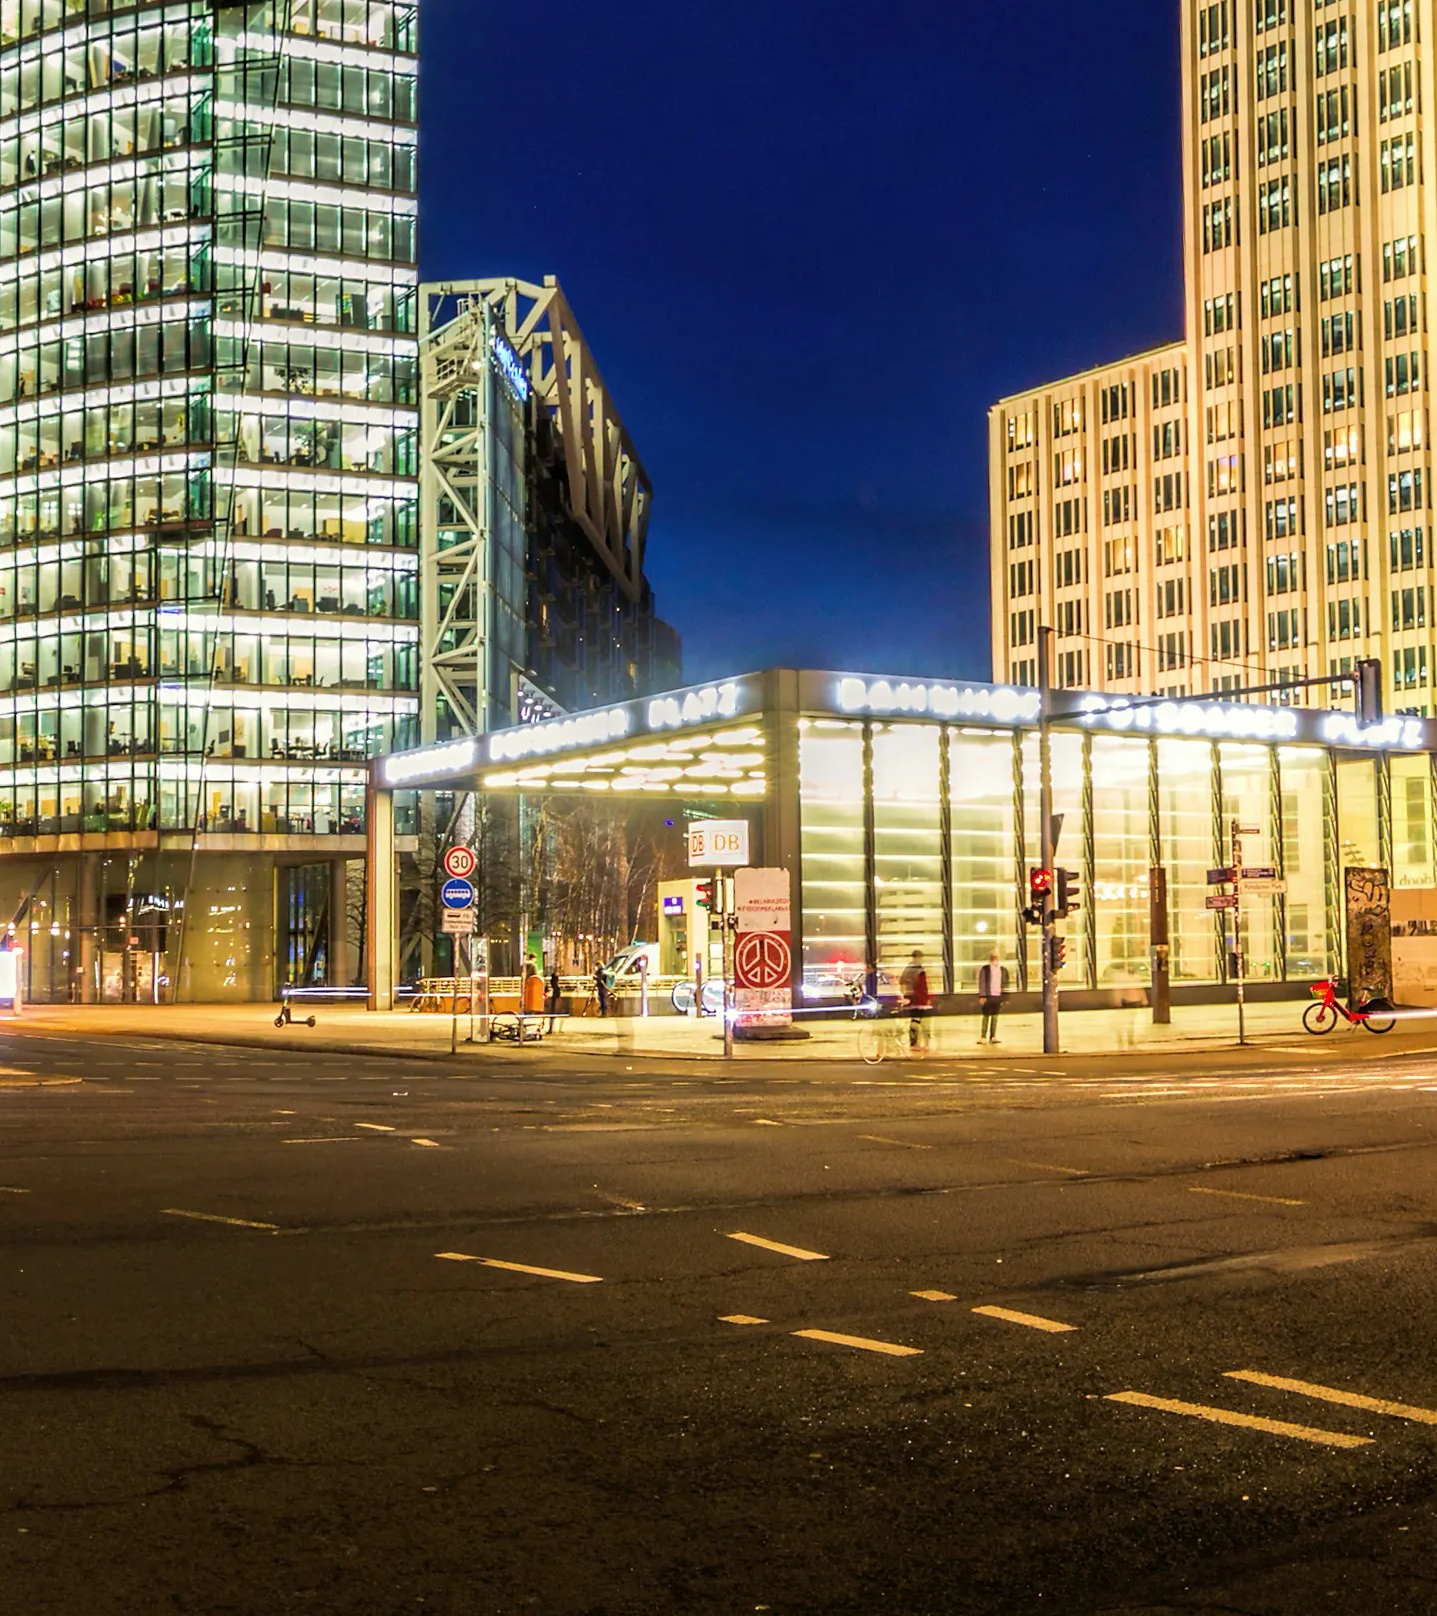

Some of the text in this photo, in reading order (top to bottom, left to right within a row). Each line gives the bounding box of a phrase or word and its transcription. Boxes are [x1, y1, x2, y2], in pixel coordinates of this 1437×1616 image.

[692, 834, 704, 853] DB
[714, 834, 740, 851] DB
[451, 855, 469, 870] 30
